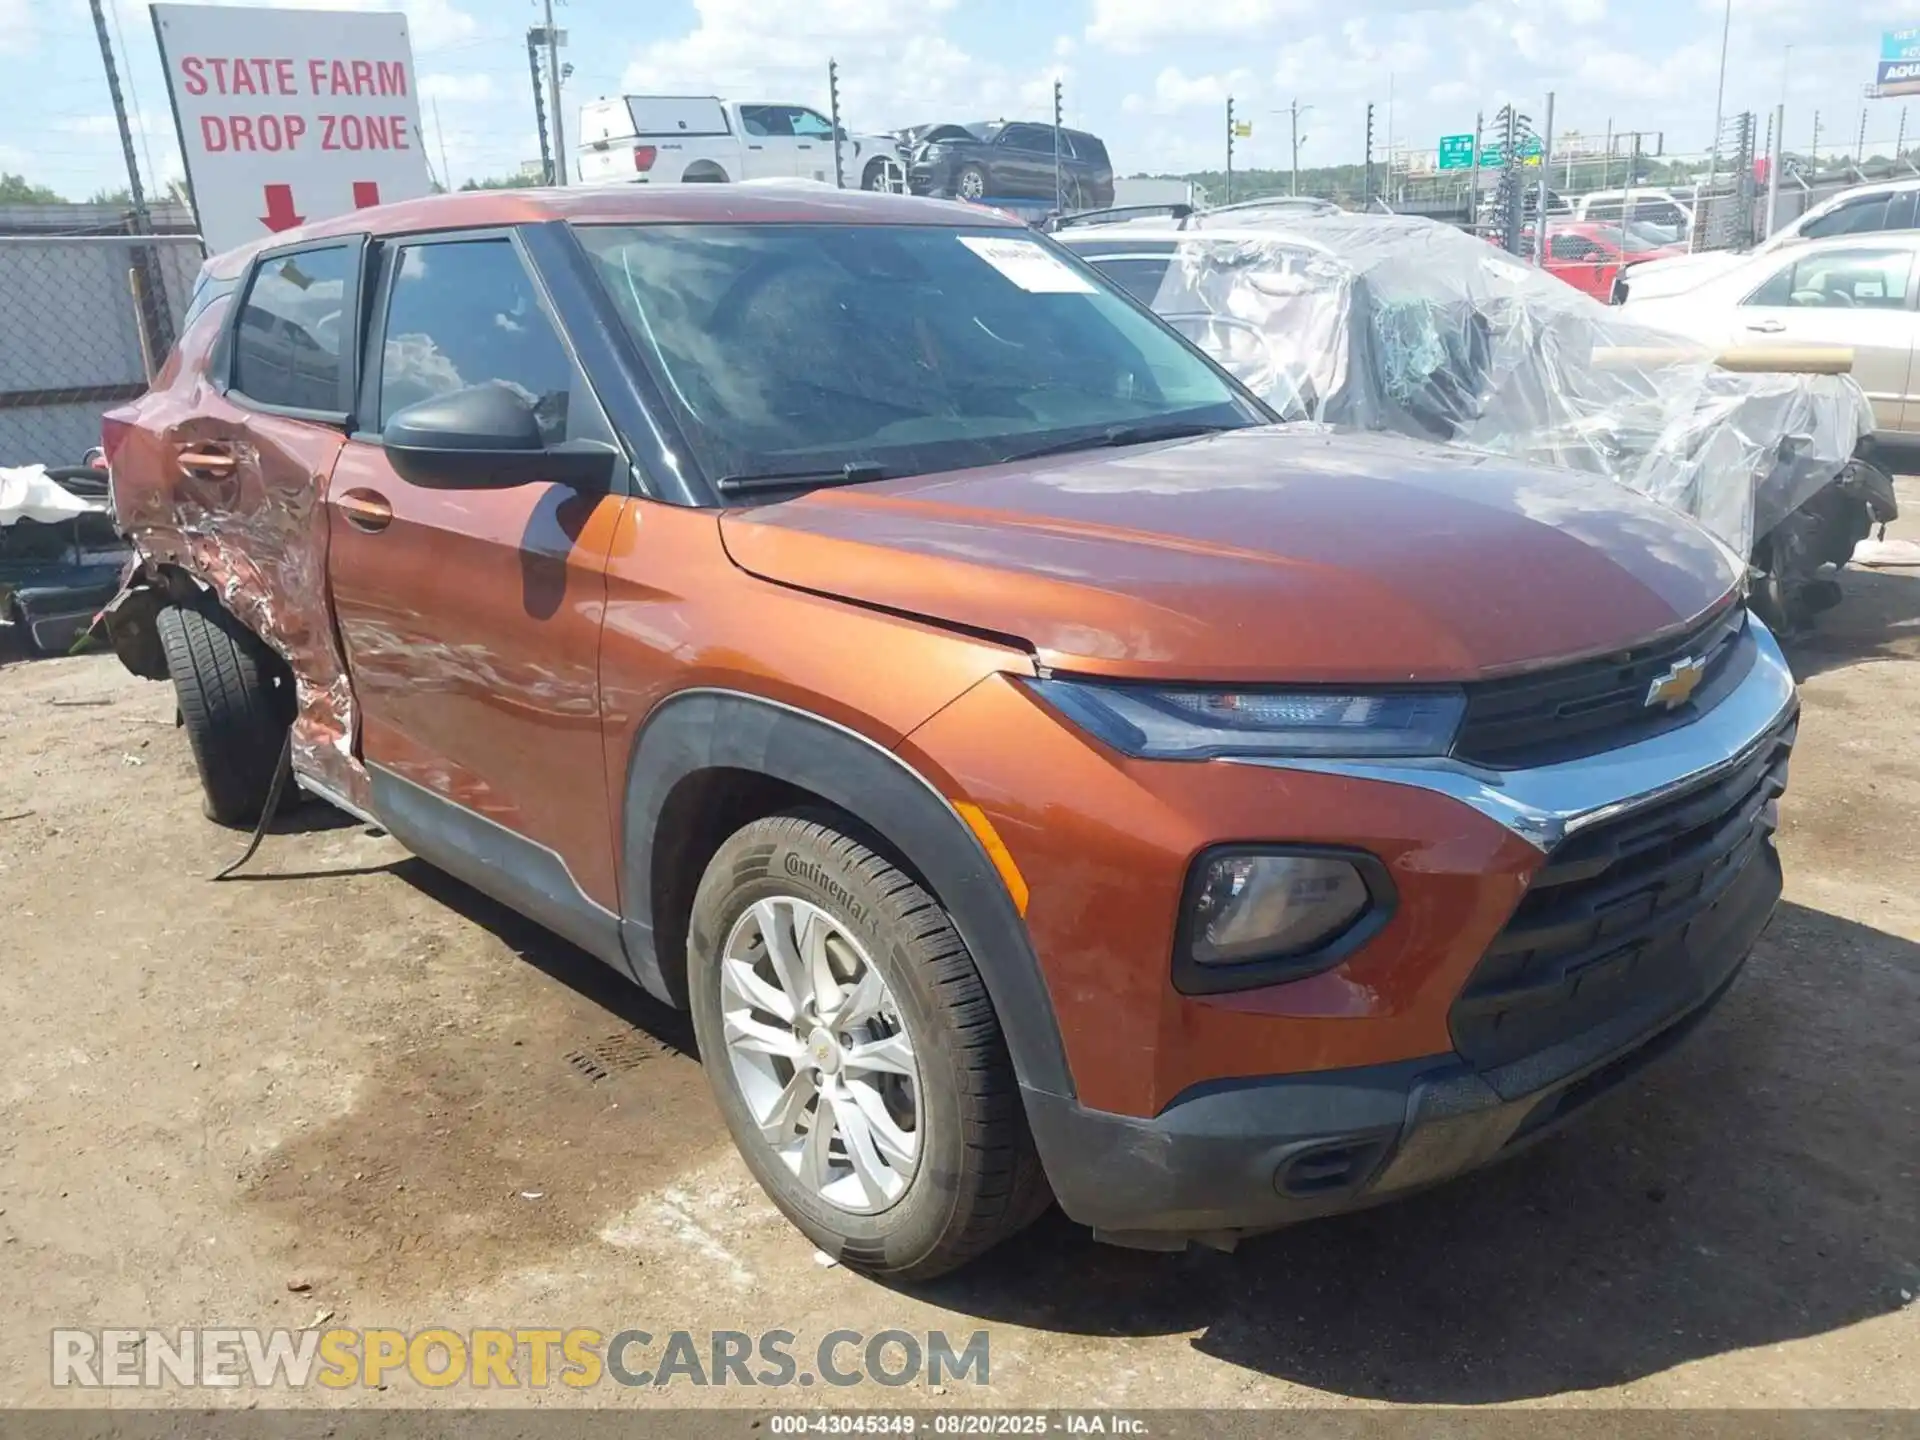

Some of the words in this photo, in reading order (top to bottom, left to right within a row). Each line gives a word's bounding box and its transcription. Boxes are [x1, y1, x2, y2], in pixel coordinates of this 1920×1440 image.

[181, 57, 298, 96] STATE
[308, 60, 407, 97] FARM
[200, 115, 306, 152] DROP
[317, 115, 410, 151] ZONE
[784, 851, 869, 925] Continental
